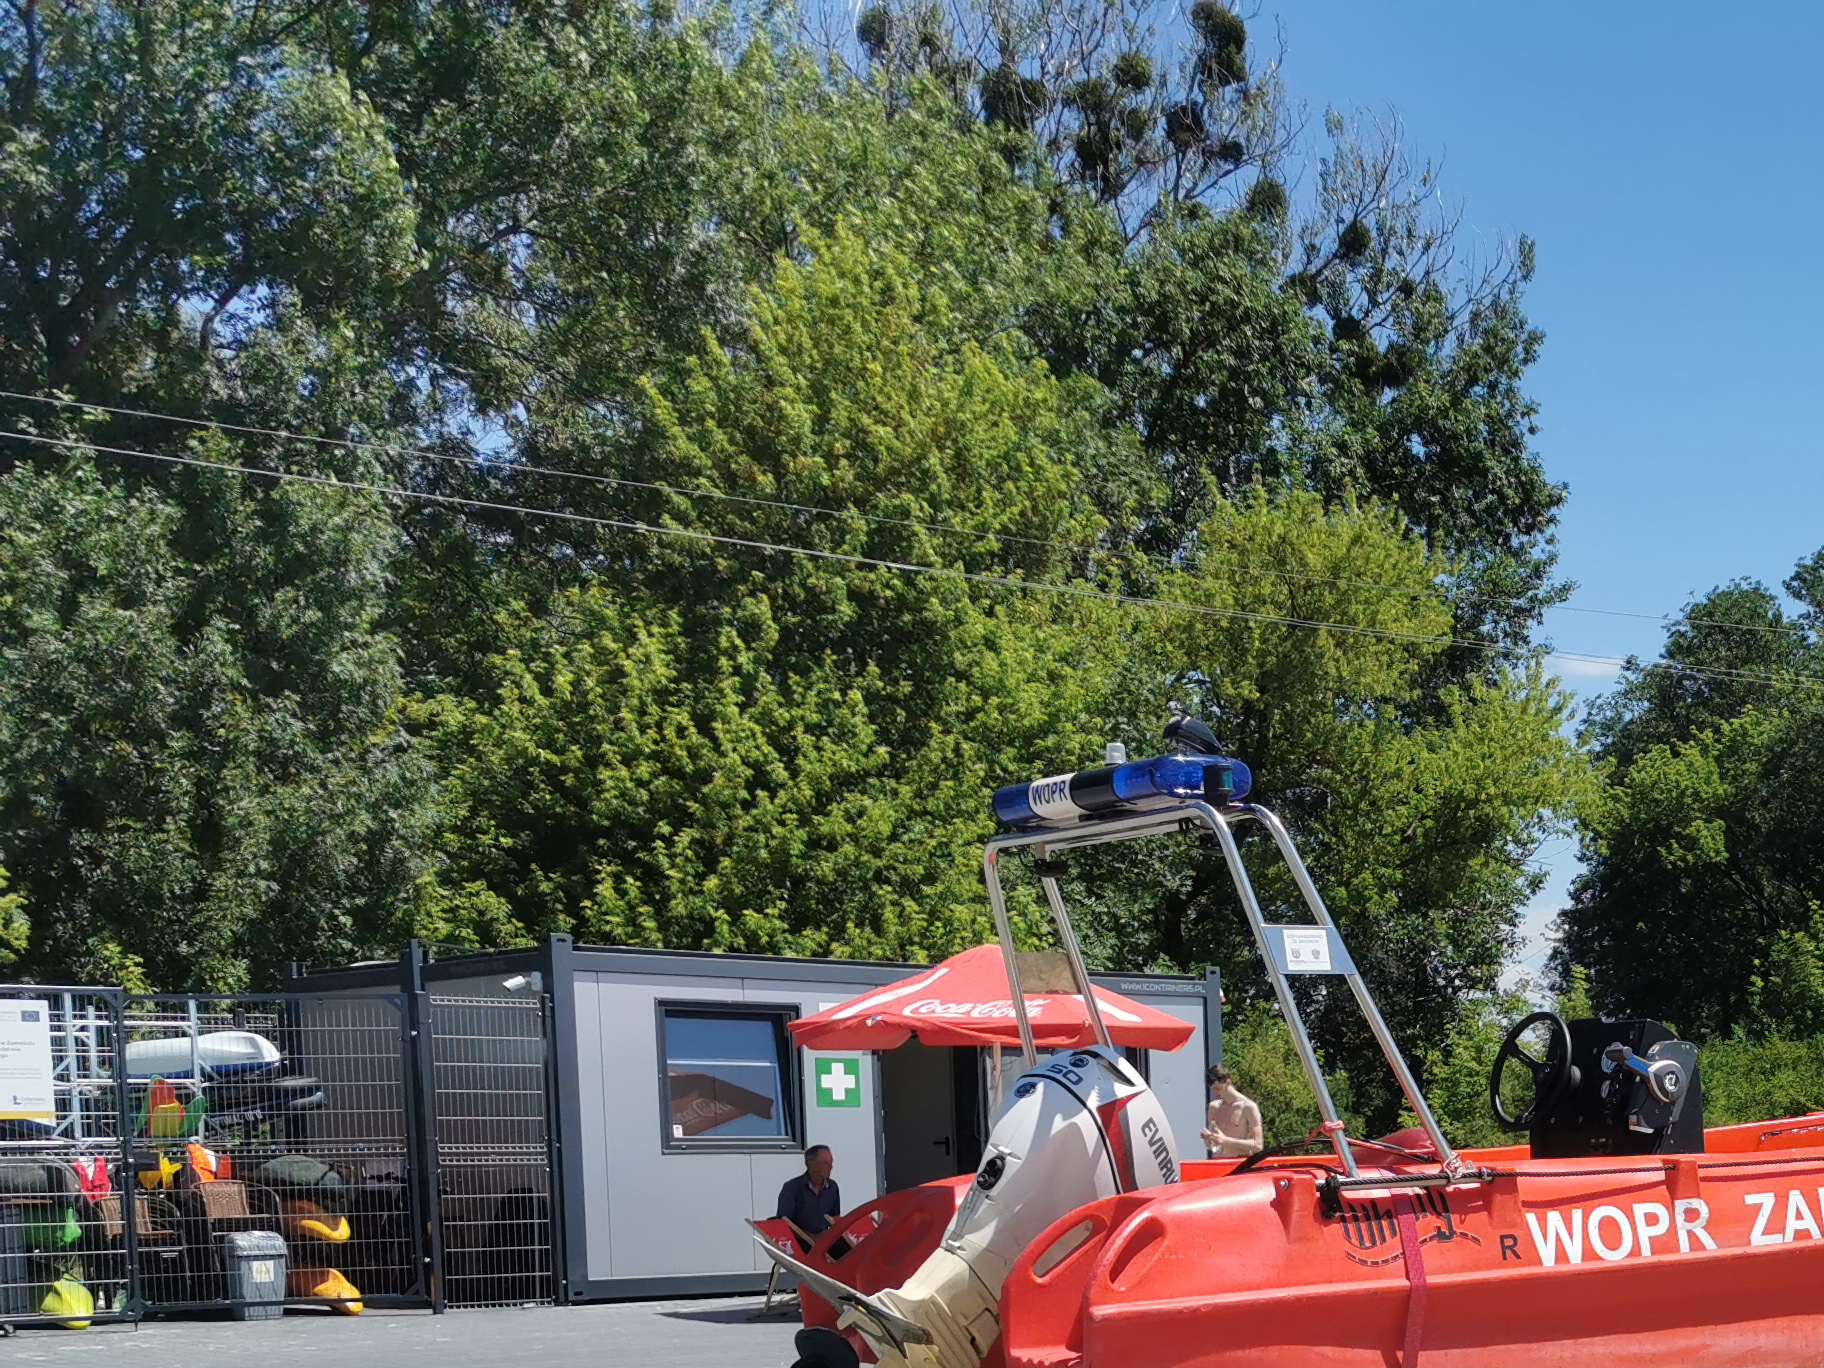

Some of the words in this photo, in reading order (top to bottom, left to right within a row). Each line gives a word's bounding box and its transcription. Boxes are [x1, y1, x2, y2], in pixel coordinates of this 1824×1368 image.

[1032, 780, 1068, 806] WOPR
[1120, 982, 1206, 993] WWW.ICONTAINERS.PL
[1046, 1063, 1084, 1086] 50
[1526, 1197, 1718, 1267] WOPR
[1499, 1233, 1522, 1261] R
